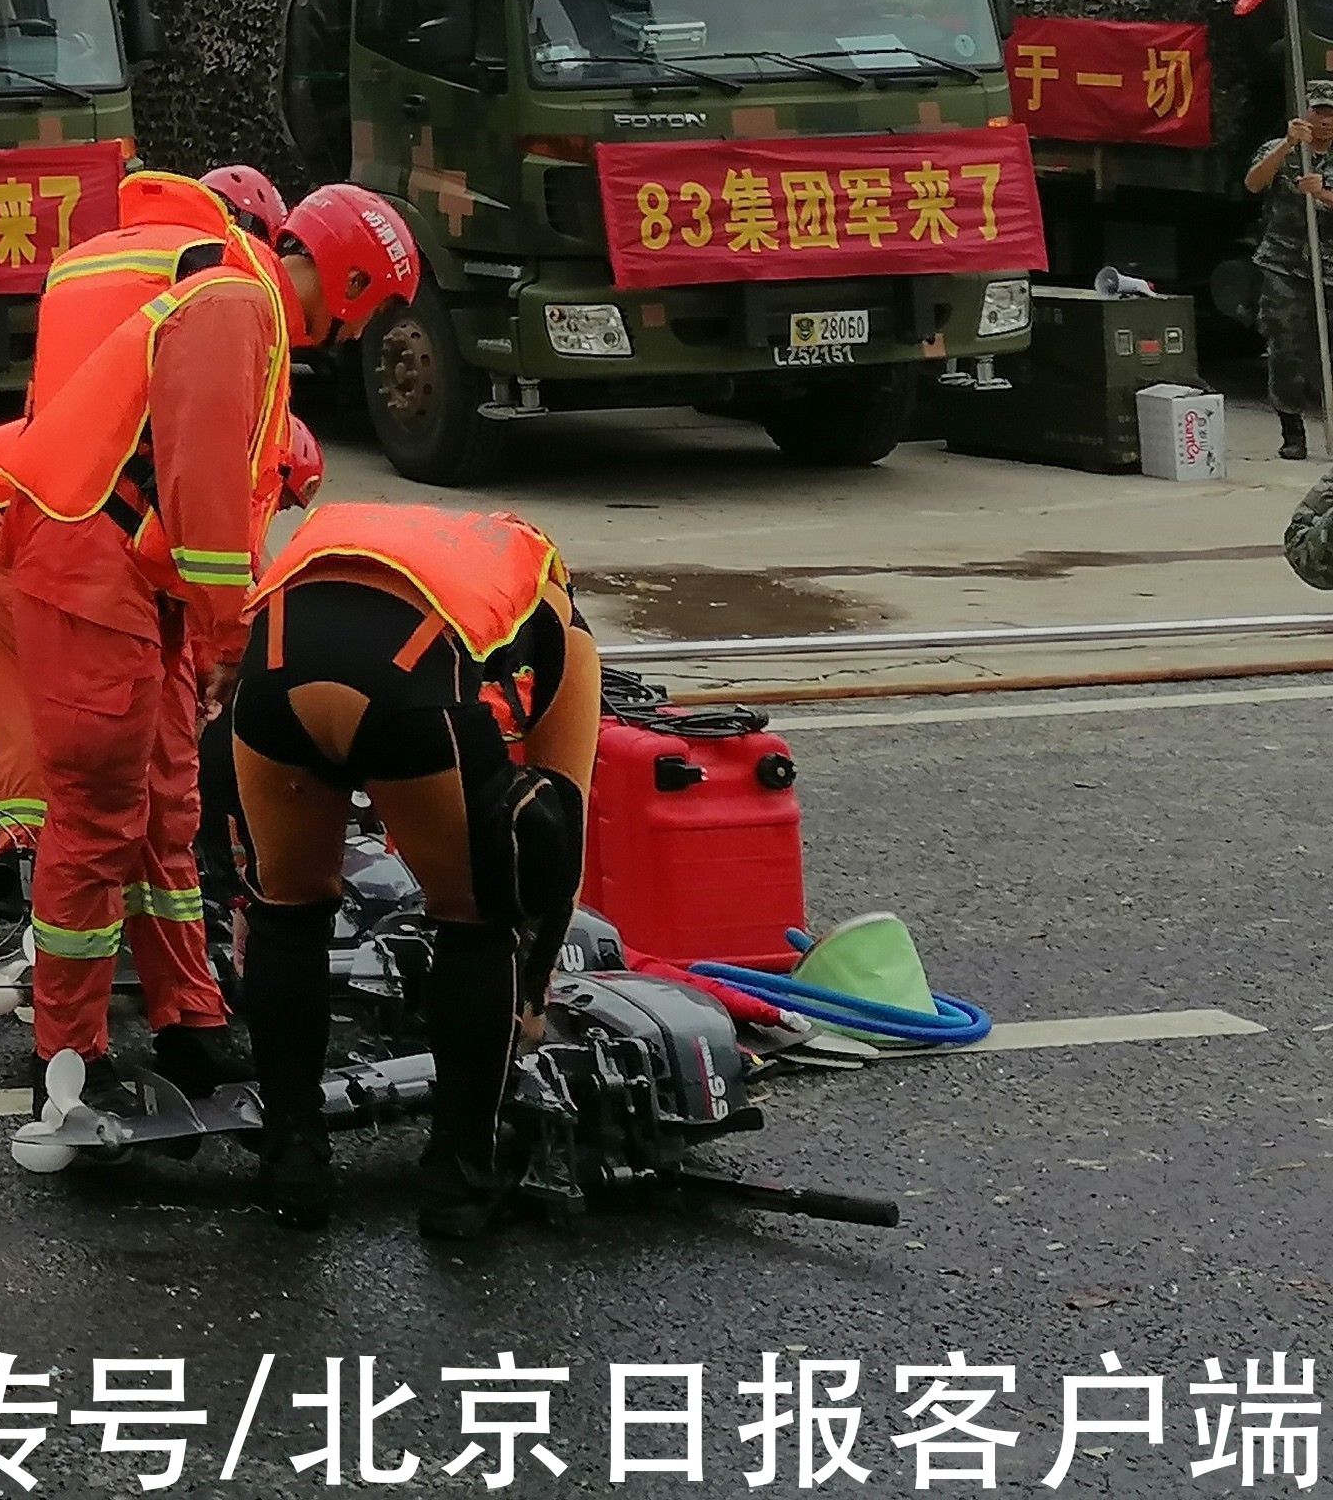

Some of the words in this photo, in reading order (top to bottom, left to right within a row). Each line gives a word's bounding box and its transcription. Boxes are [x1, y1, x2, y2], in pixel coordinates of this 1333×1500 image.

[613, 112, 707, 129] FOTON
[636, 160, 1002, 253] 83集团军来了
[820, 315, 866, 341] 28060
